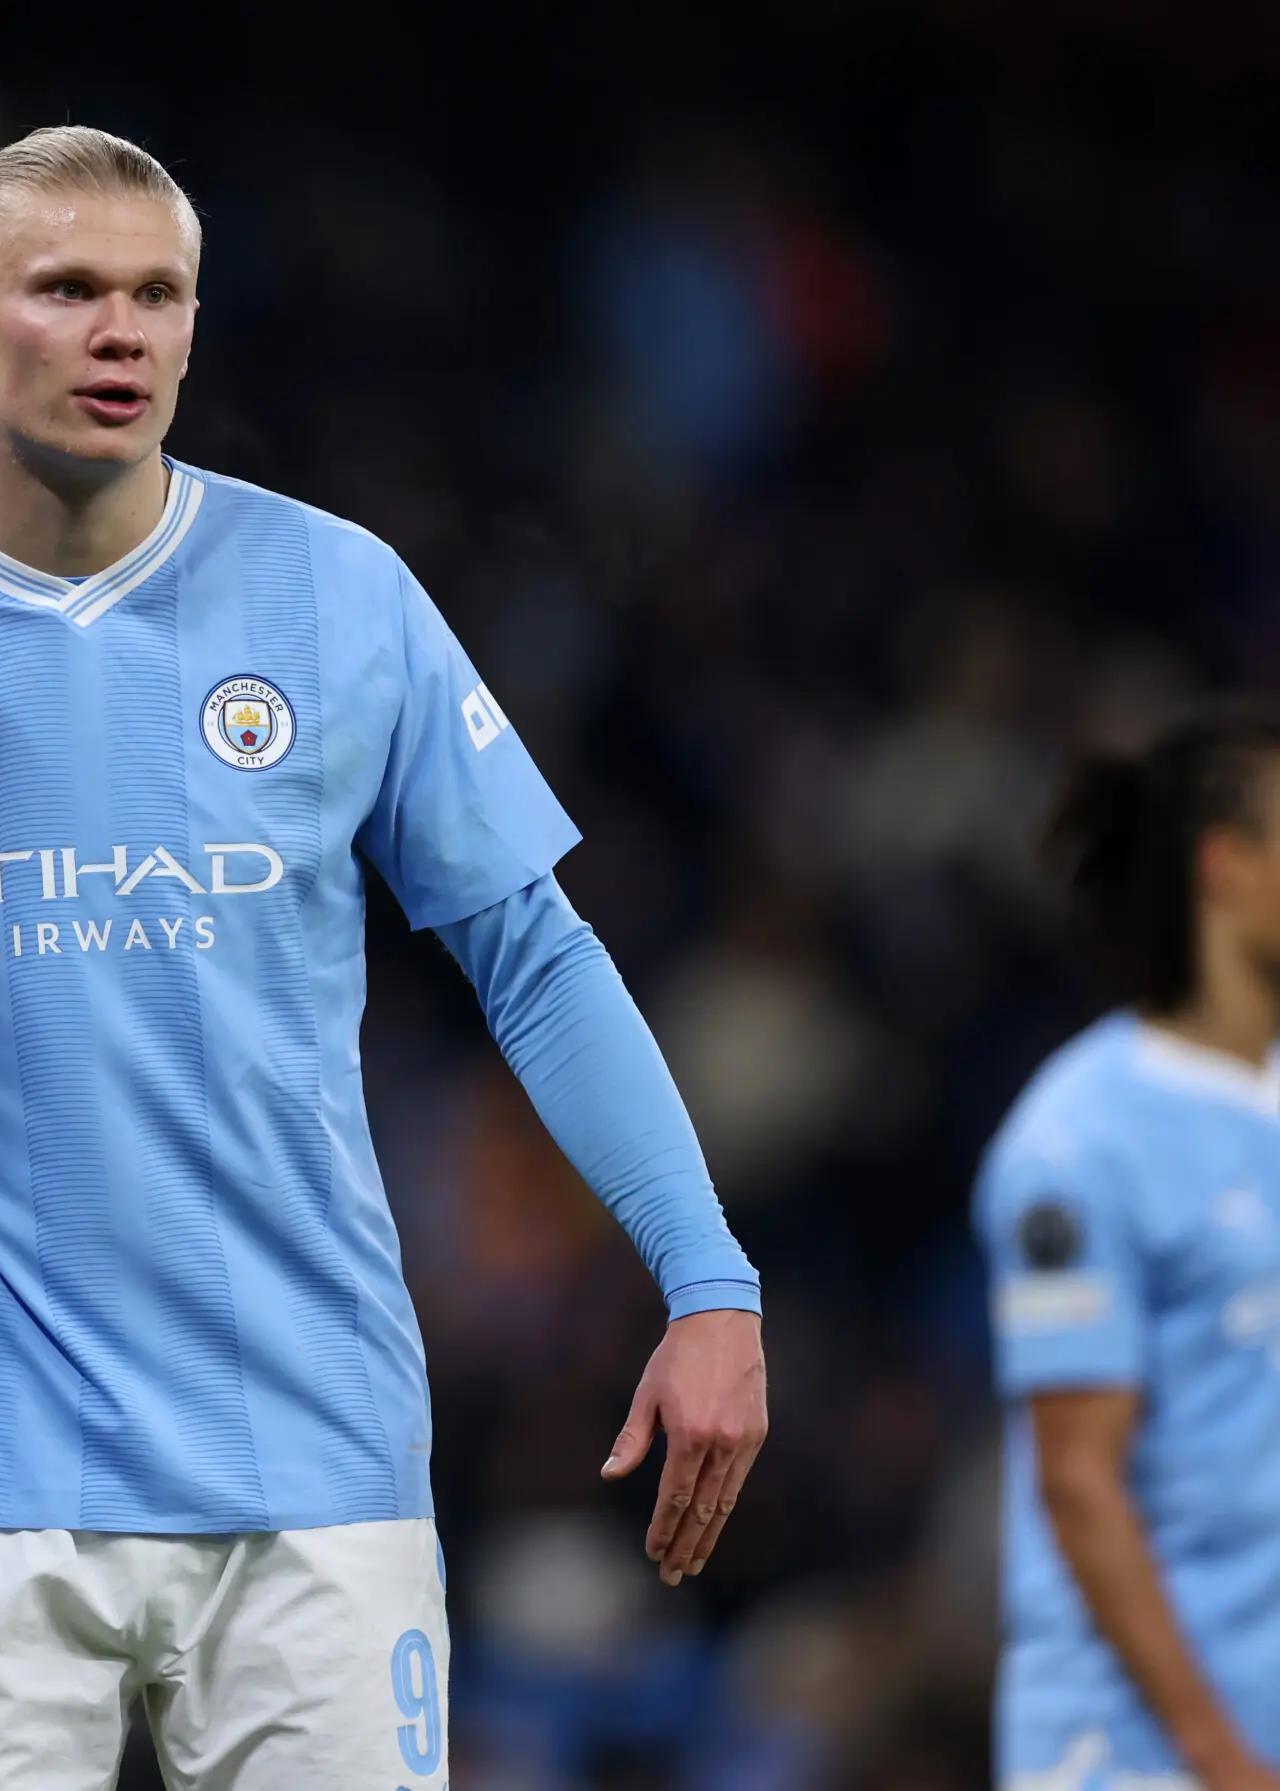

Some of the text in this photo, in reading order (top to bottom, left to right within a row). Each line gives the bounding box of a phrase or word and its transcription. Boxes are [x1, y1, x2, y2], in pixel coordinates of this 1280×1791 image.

[210, 682, 283, 712] MANCHESTER
[237, 756, 264, 765] CITY
[391, 1629, 441, 1777] 9
